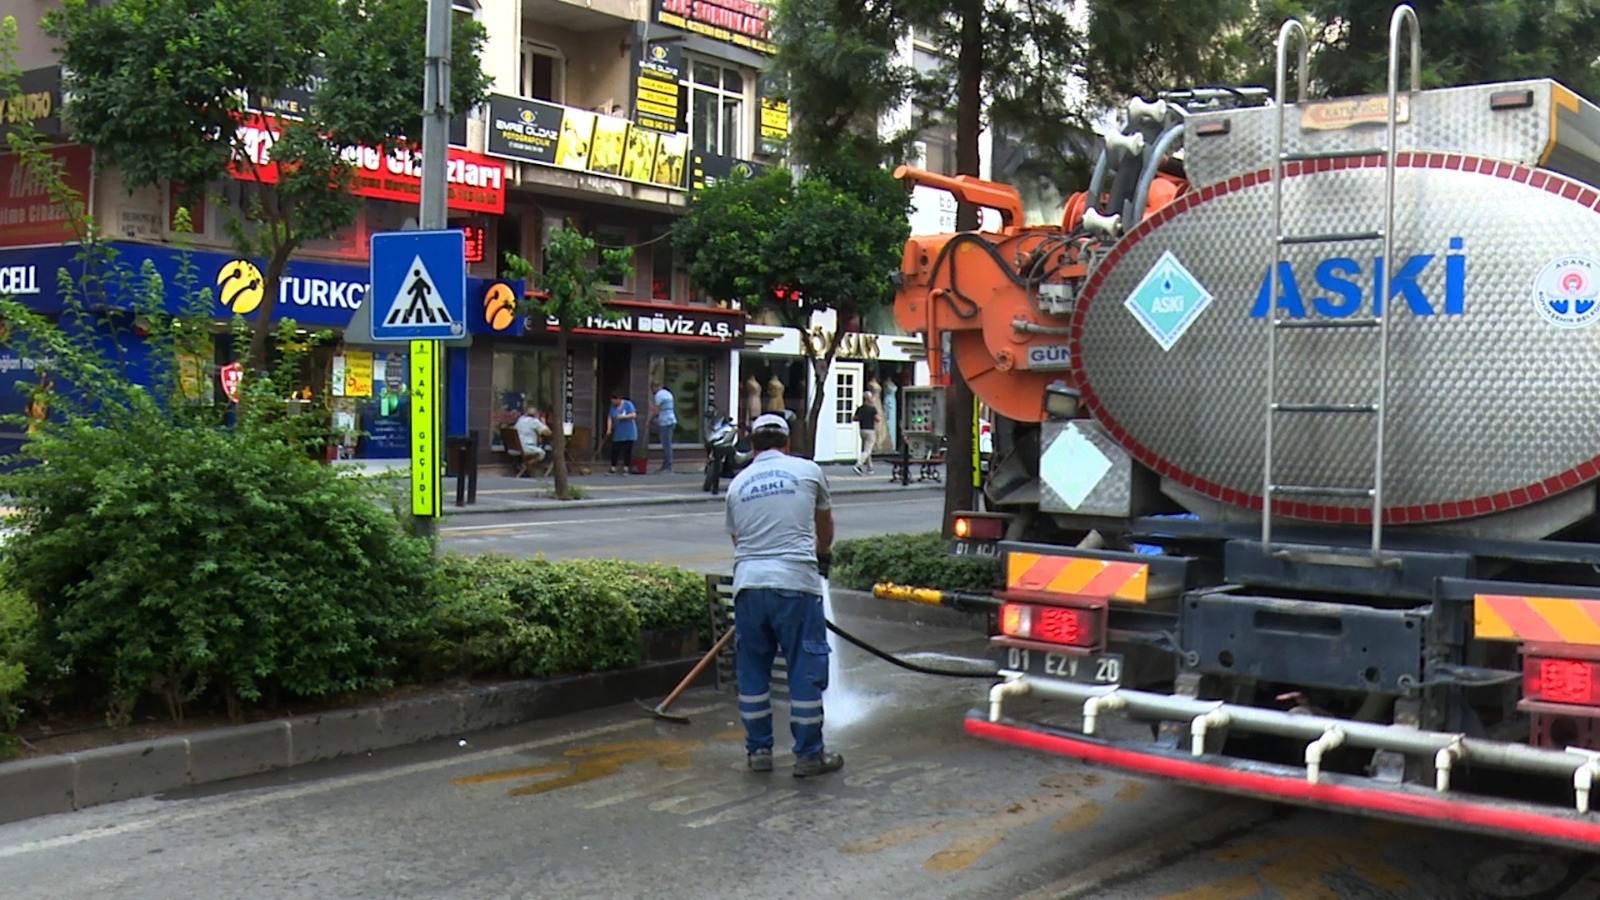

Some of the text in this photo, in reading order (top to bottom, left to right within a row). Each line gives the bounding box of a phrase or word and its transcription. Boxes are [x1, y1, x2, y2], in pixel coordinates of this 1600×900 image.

[1250, 236, 1465, 318] ASKİ
[638, 313, 694, 335] DÖVİZ
[1095, 657, 1120, 682] 20
